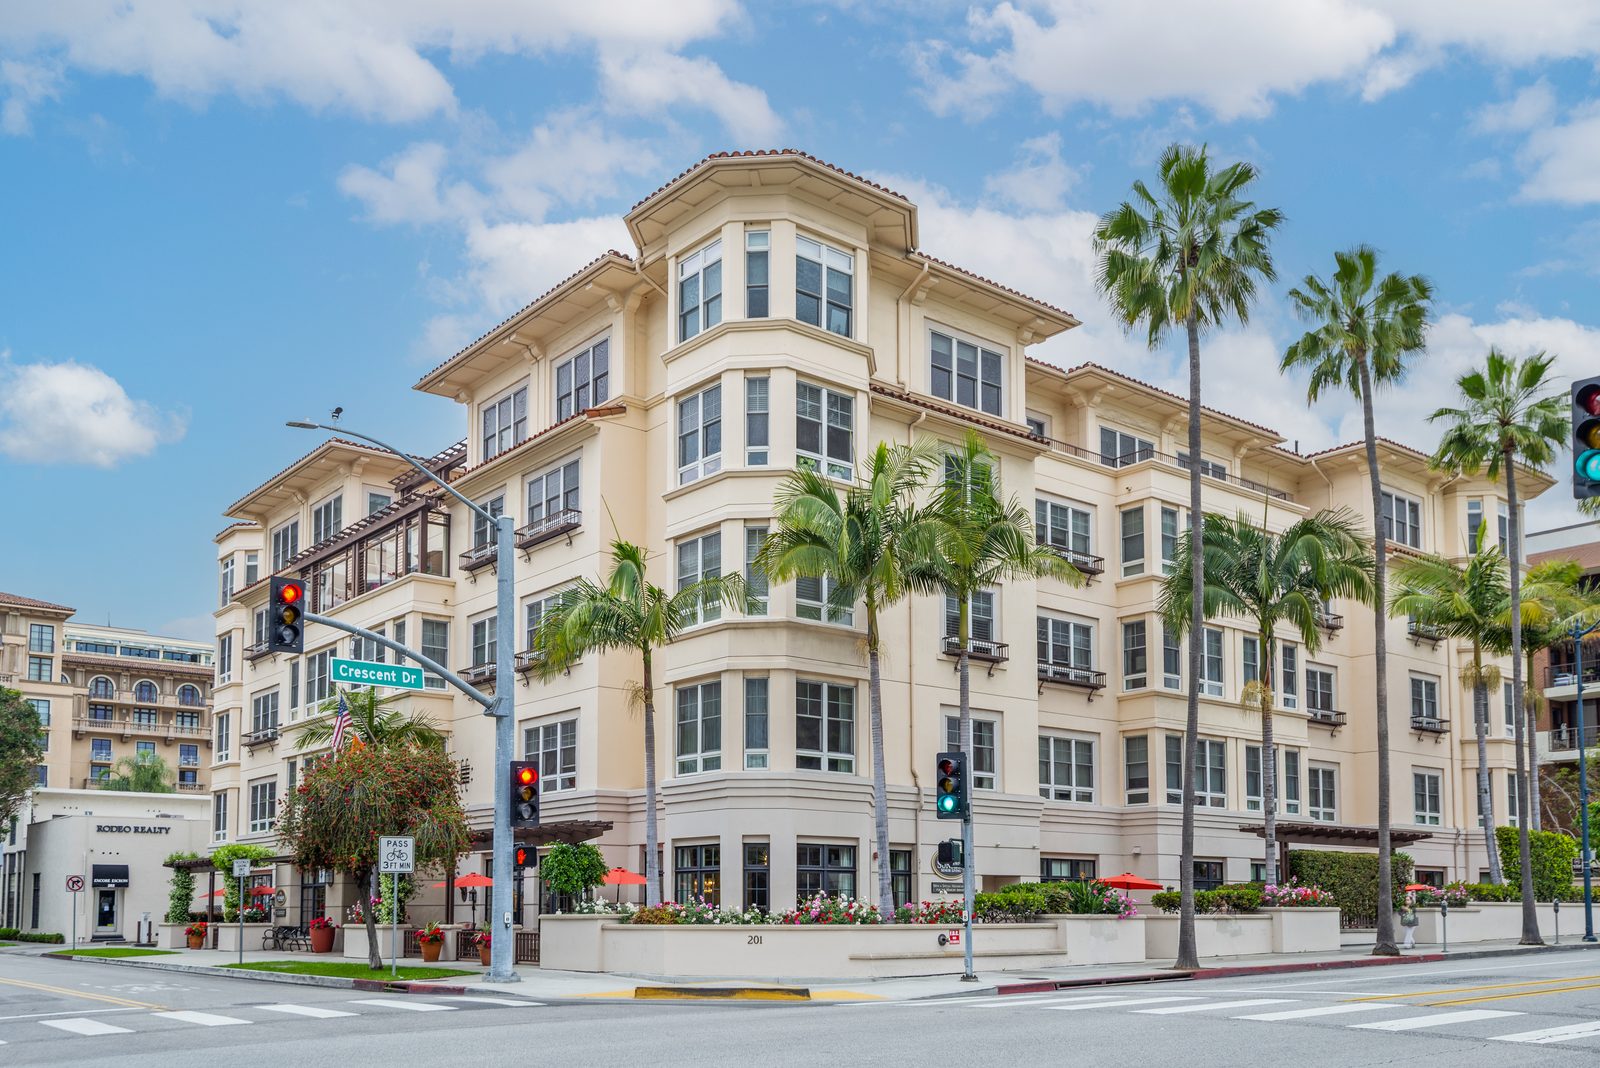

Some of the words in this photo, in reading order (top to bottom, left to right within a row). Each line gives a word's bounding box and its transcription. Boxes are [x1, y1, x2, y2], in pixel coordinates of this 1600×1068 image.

[339, 664, 396, 682] Crescent
[402, 671, 417, 684] Dr
[96, 825, 131, 833] RODEO
[133, 826, 171, 834] REALTY
[386, 840, 409, 848] PASS
[747, 935, 763, 945] 201
